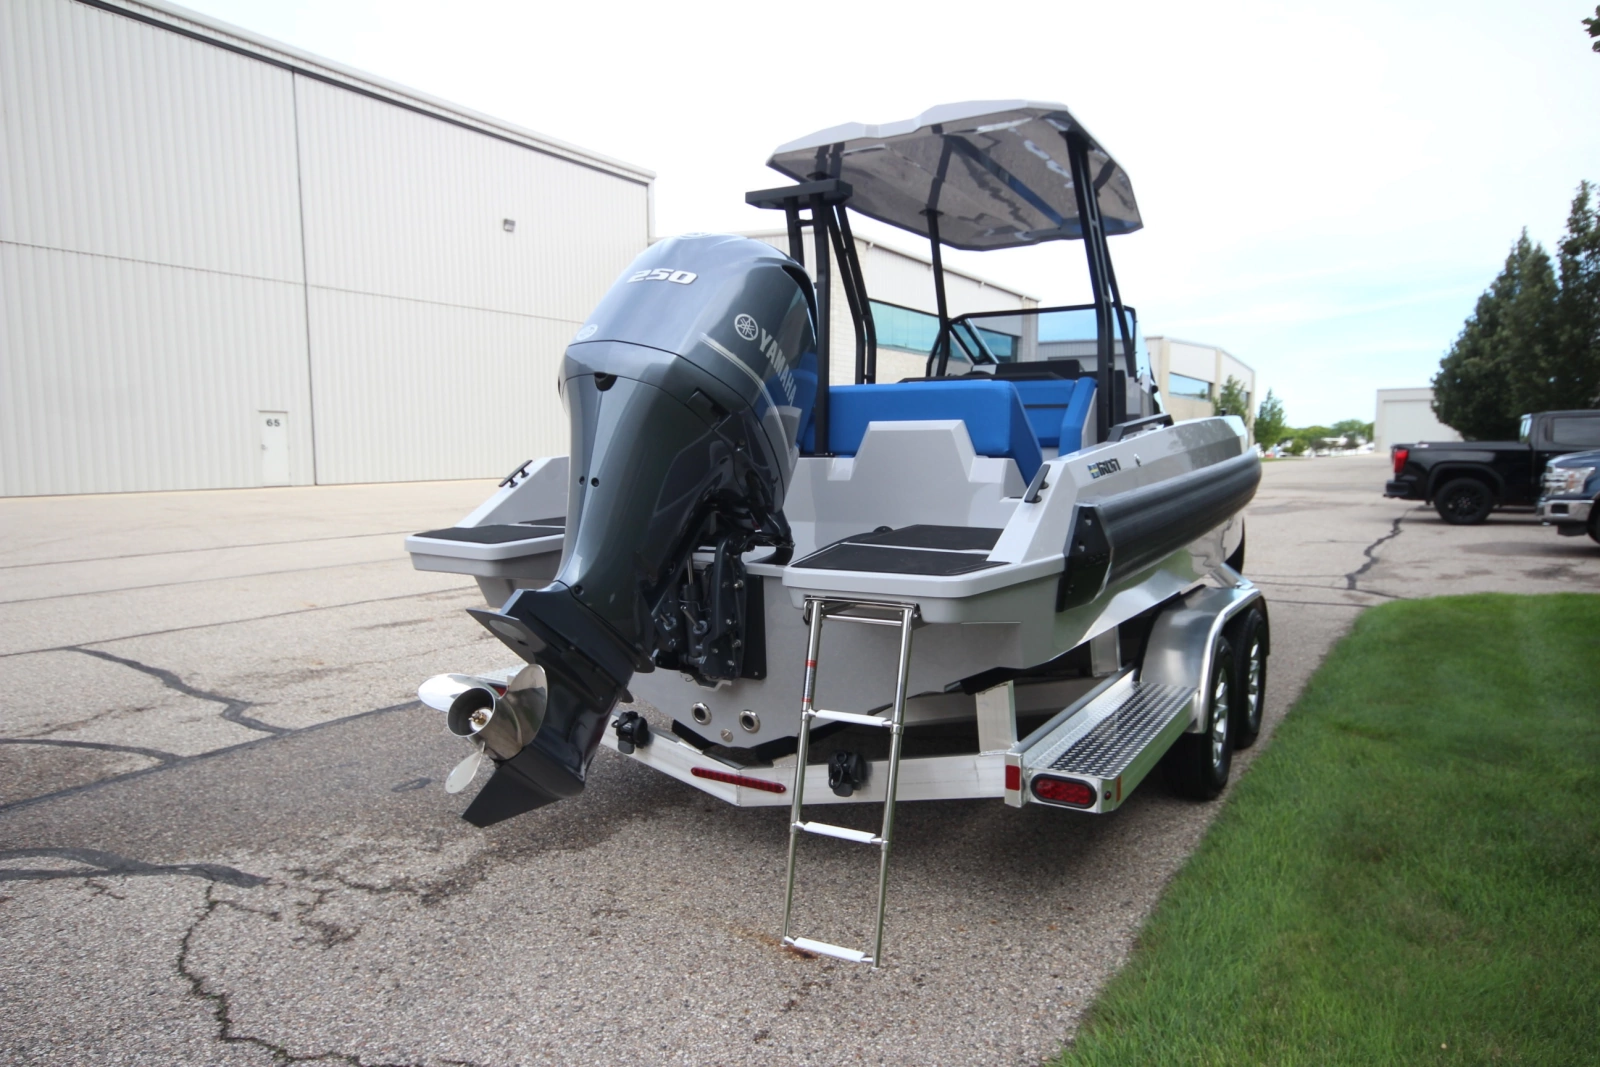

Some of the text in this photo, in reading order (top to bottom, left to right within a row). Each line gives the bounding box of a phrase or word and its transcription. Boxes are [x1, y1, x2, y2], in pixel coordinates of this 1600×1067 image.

[626, 267, 698, 285] 250
[759, 327, 797, 407] YAMAHA
[266, 418, 281, 427] 65
